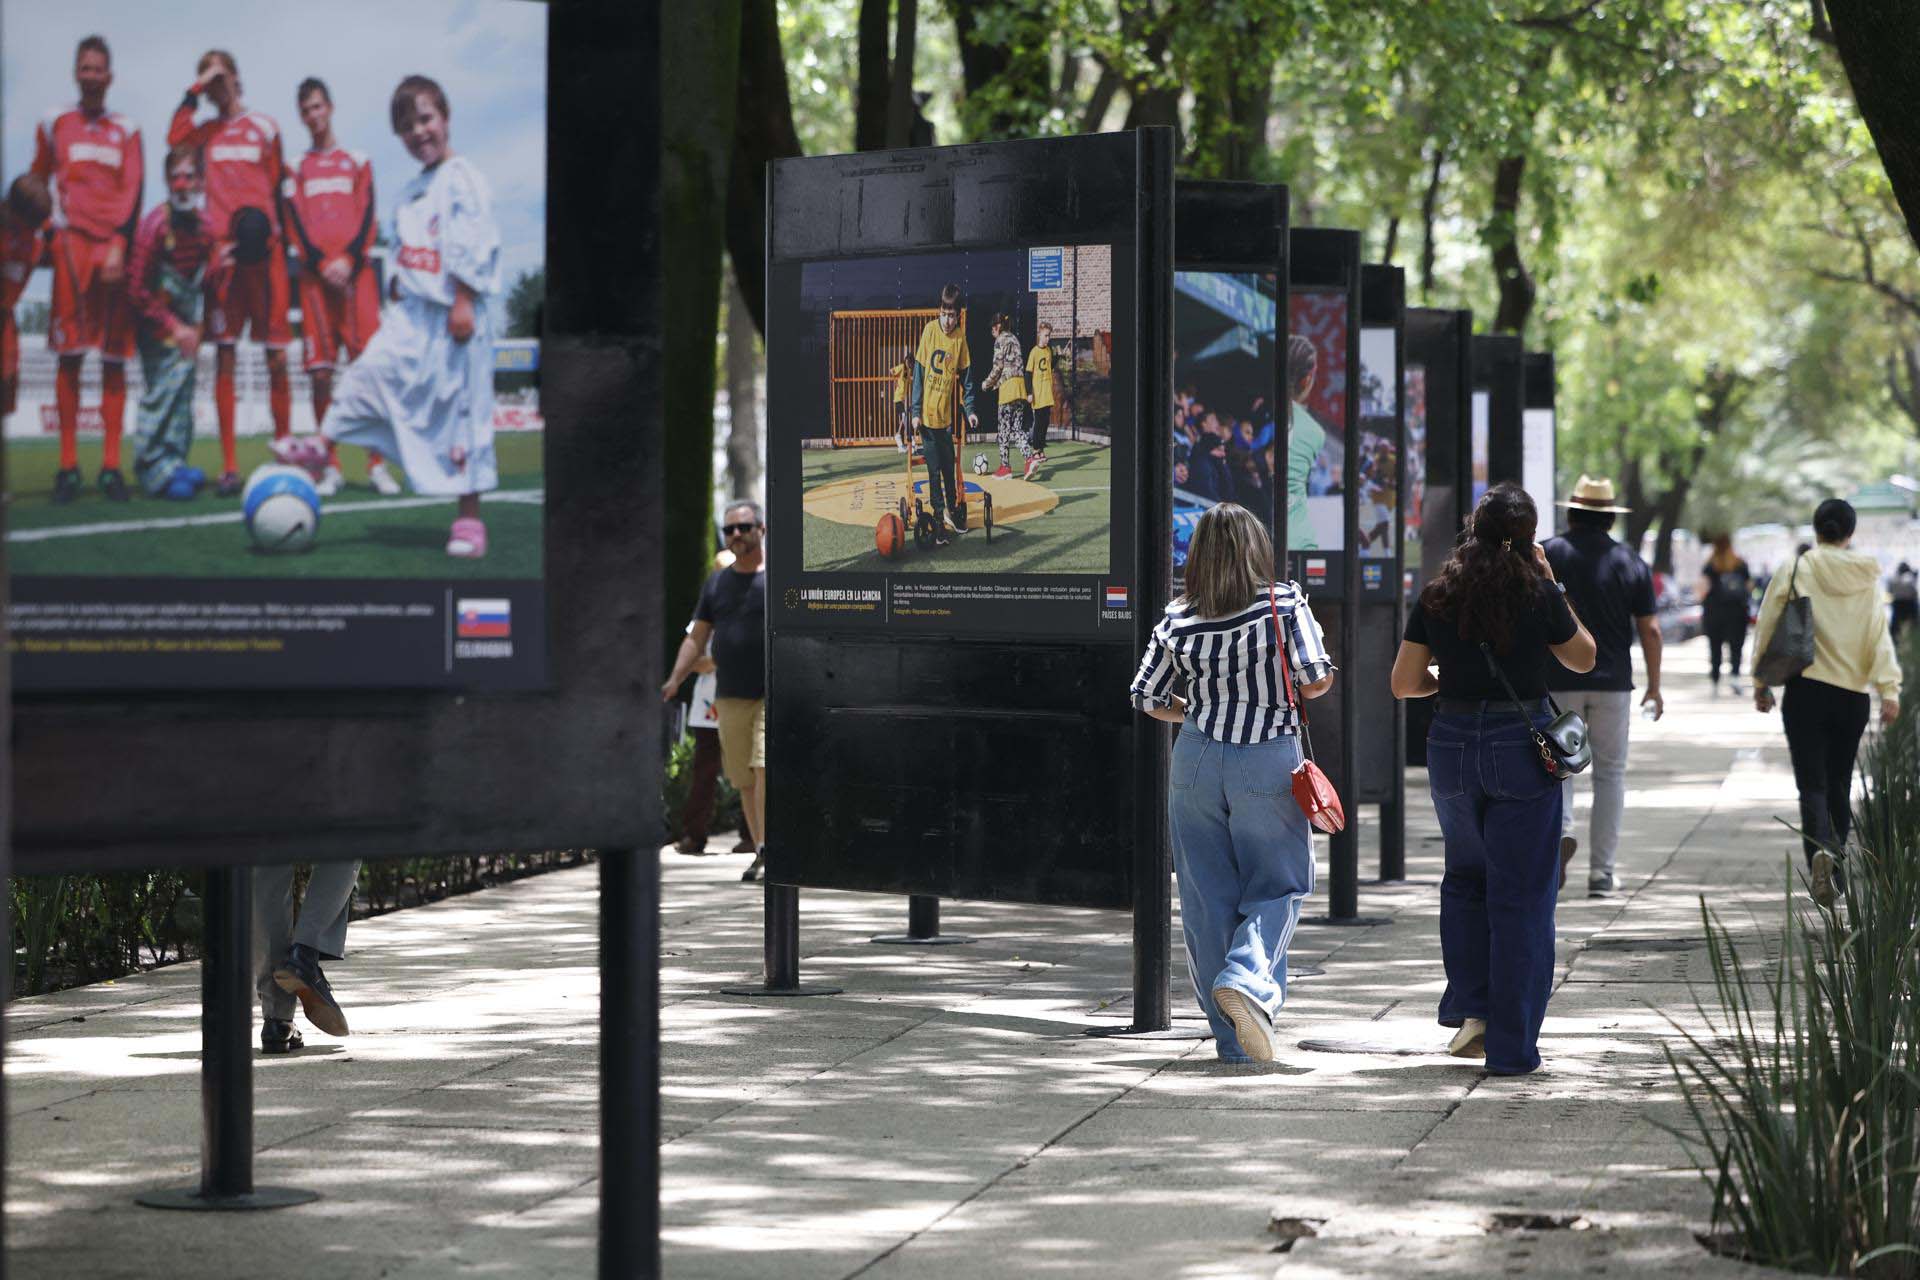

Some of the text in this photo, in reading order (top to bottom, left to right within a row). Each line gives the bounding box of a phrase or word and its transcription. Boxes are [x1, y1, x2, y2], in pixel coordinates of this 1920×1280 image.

[800, 587, 881, 601] LA UNIÓN EUROPEA EN LA CANCHA
[1101, 608, 1132, 620] PAÍSES BAJOS
